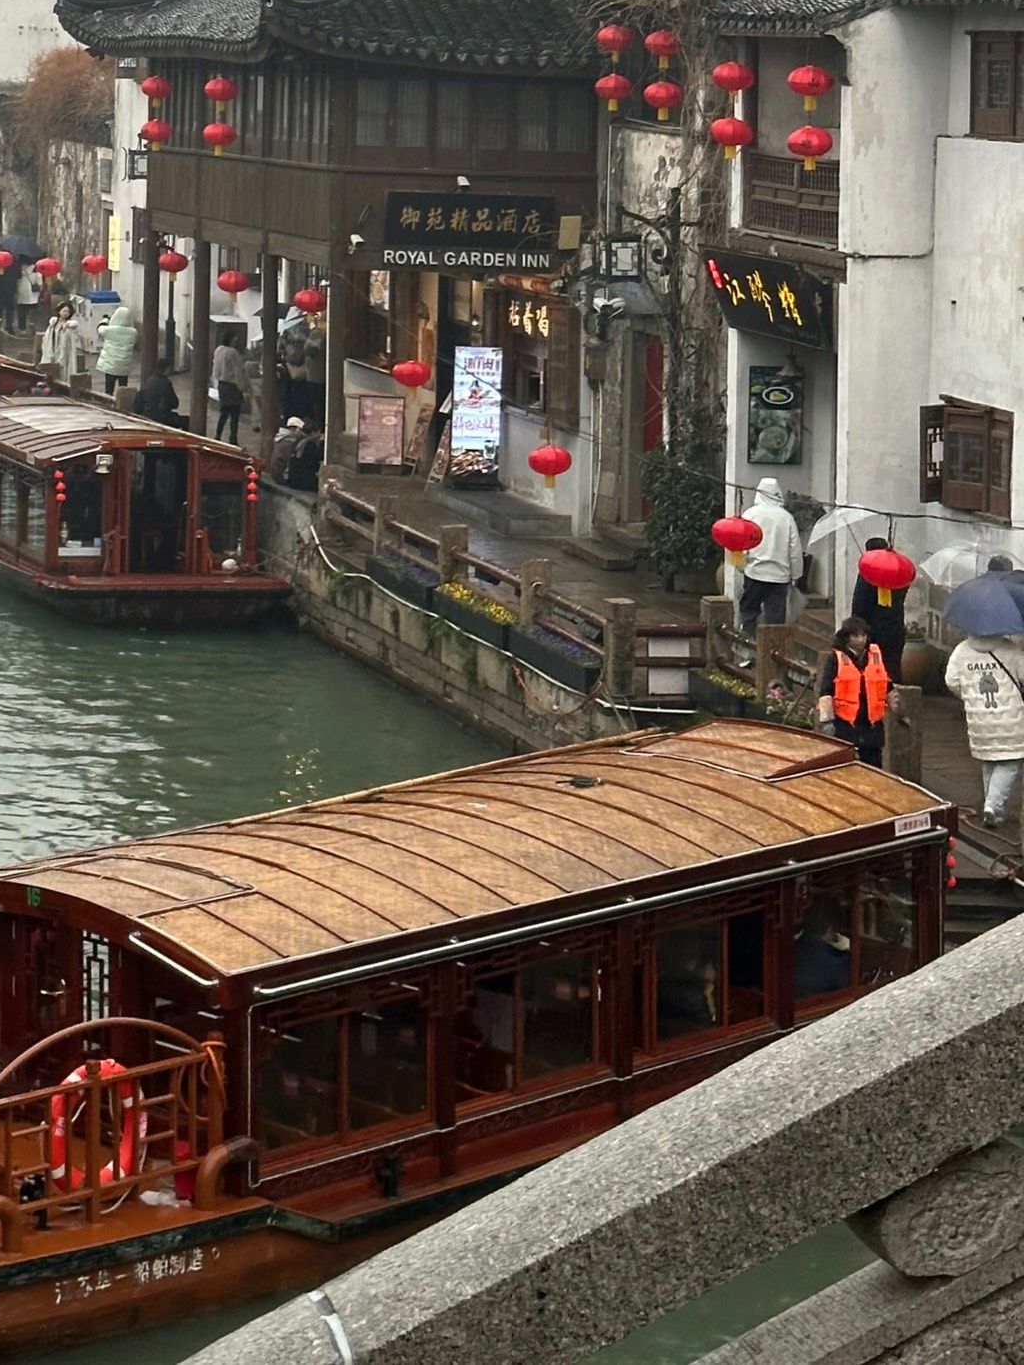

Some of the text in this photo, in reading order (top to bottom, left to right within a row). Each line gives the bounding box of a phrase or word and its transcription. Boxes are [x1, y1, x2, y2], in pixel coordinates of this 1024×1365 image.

[400, 205, 542, 234] 御苑精品酒店
[383, 250, 550, 269] ROYAL GARDEN INN
